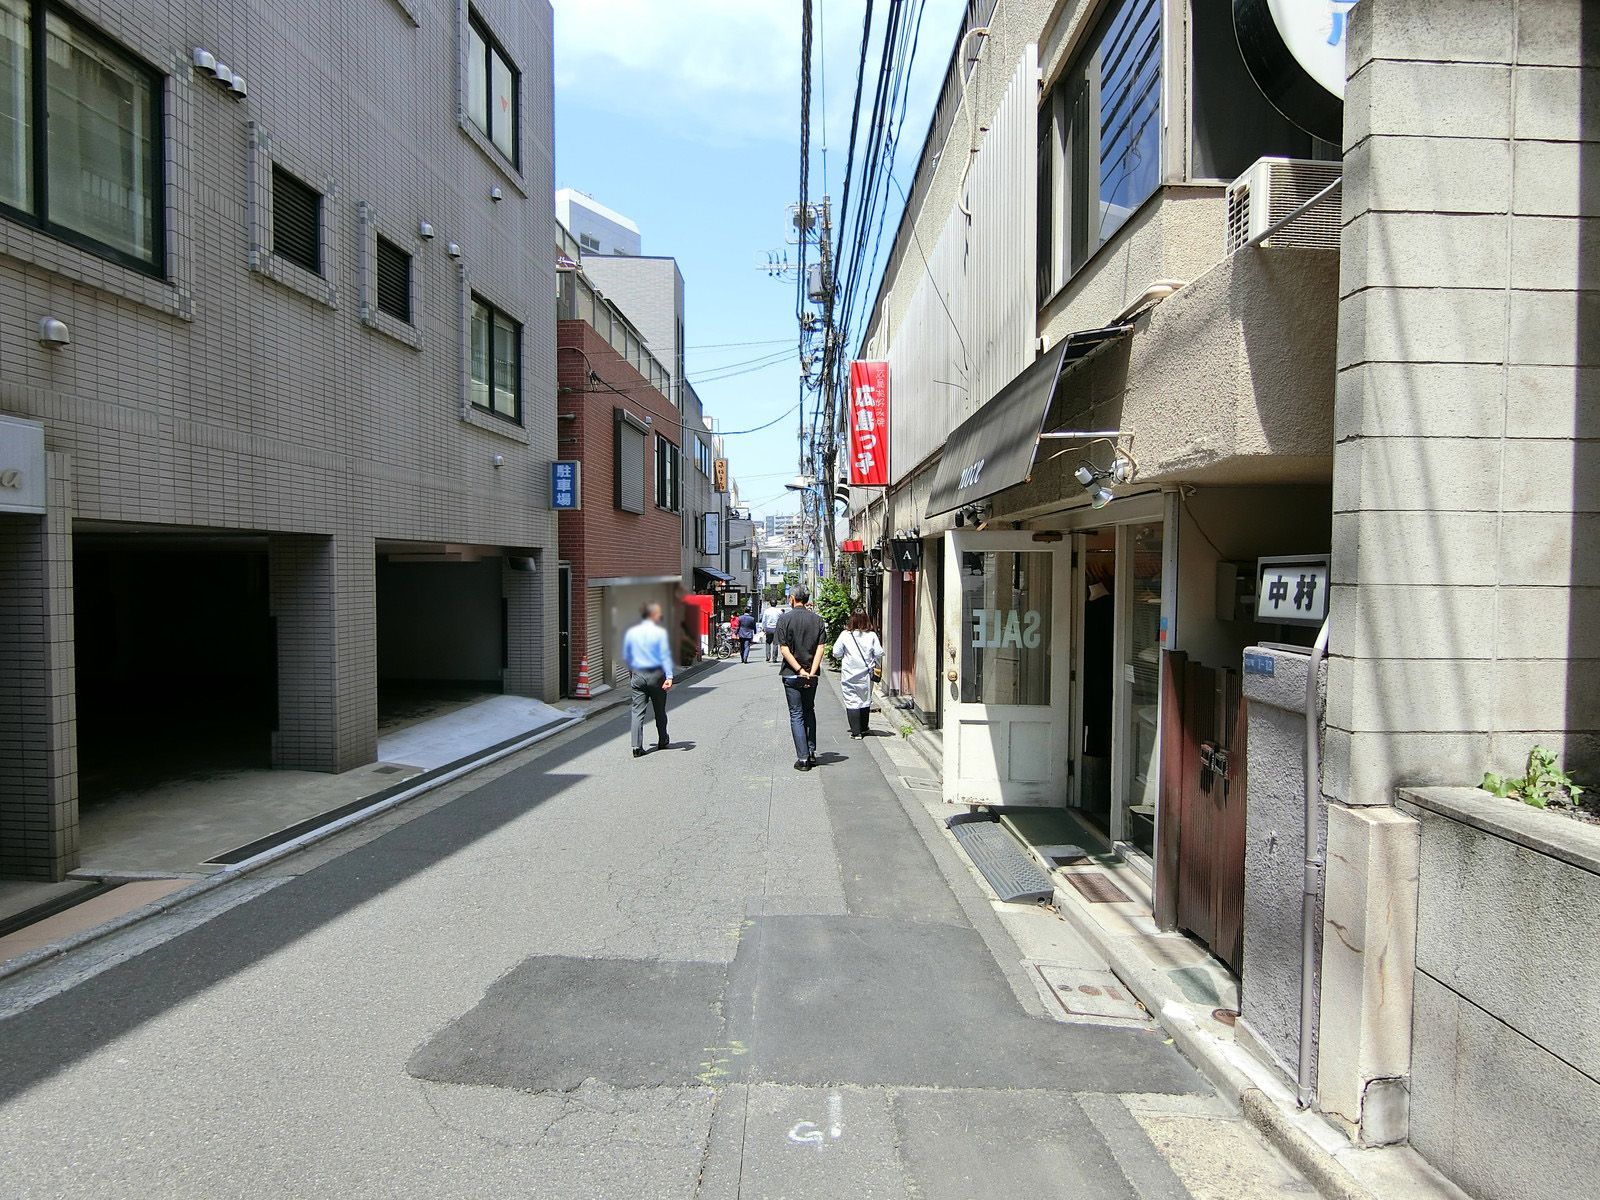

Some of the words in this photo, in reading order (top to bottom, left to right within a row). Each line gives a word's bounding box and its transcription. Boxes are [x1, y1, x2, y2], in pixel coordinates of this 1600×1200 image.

[556, 464, 572, 506] 駐車場
[903, 550, 912, 560] A
[1268, 574, 1317, 611] 中村
